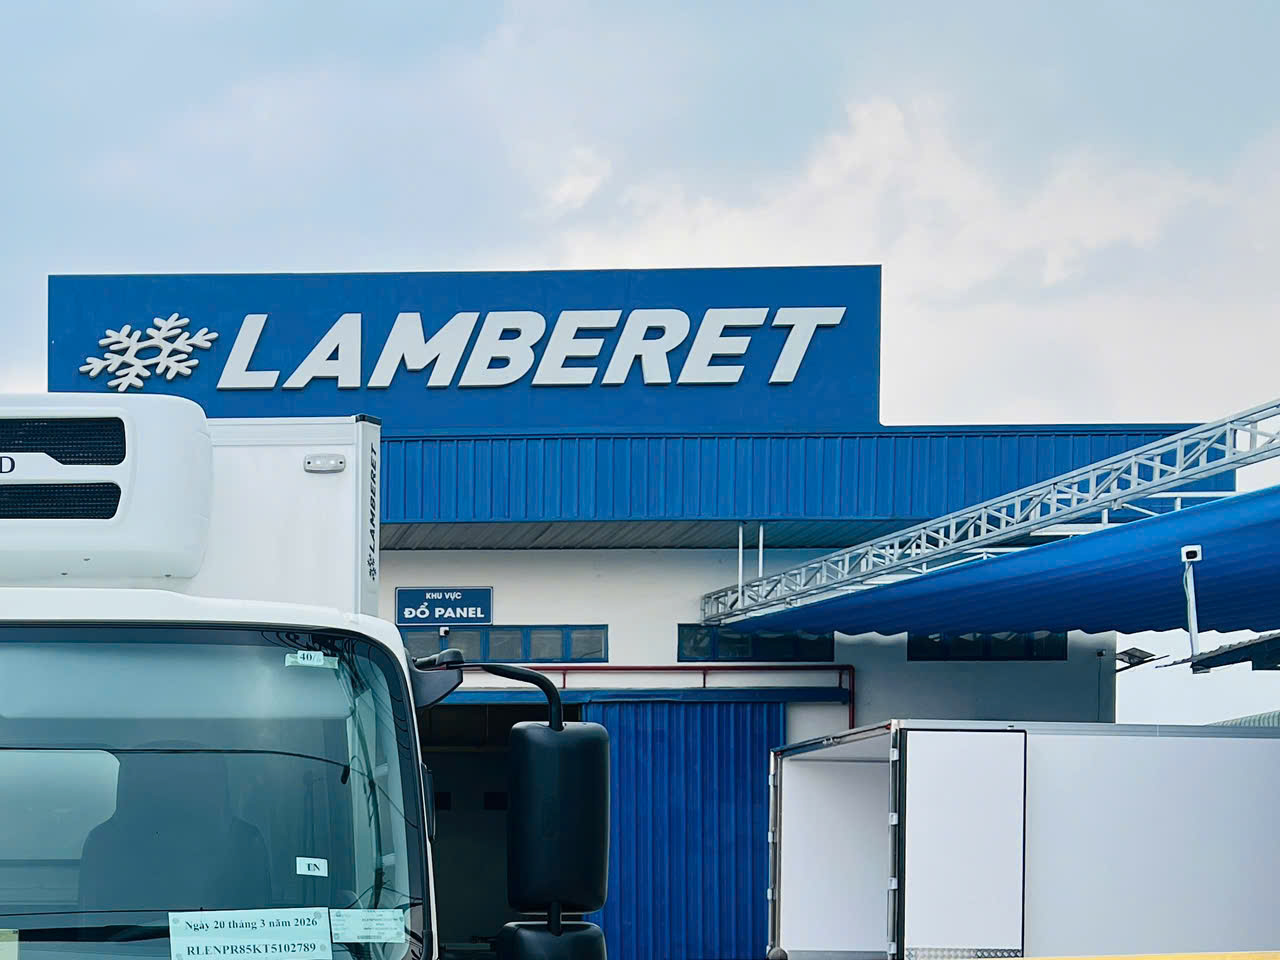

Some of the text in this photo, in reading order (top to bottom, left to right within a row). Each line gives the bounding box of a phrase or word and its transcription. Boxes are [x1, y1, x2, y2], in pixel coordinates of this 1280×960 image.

[216, 306, 847, 389] LAMBERET
[369, 442, 378, 554] LAMBERET
[425, 591, 462, 601] KHU VỰC
[404, 602, 485, 618] ĐỔ PANEL
[185, 917, 318, 932] Ngày 20 tháng 3 năm 2026
